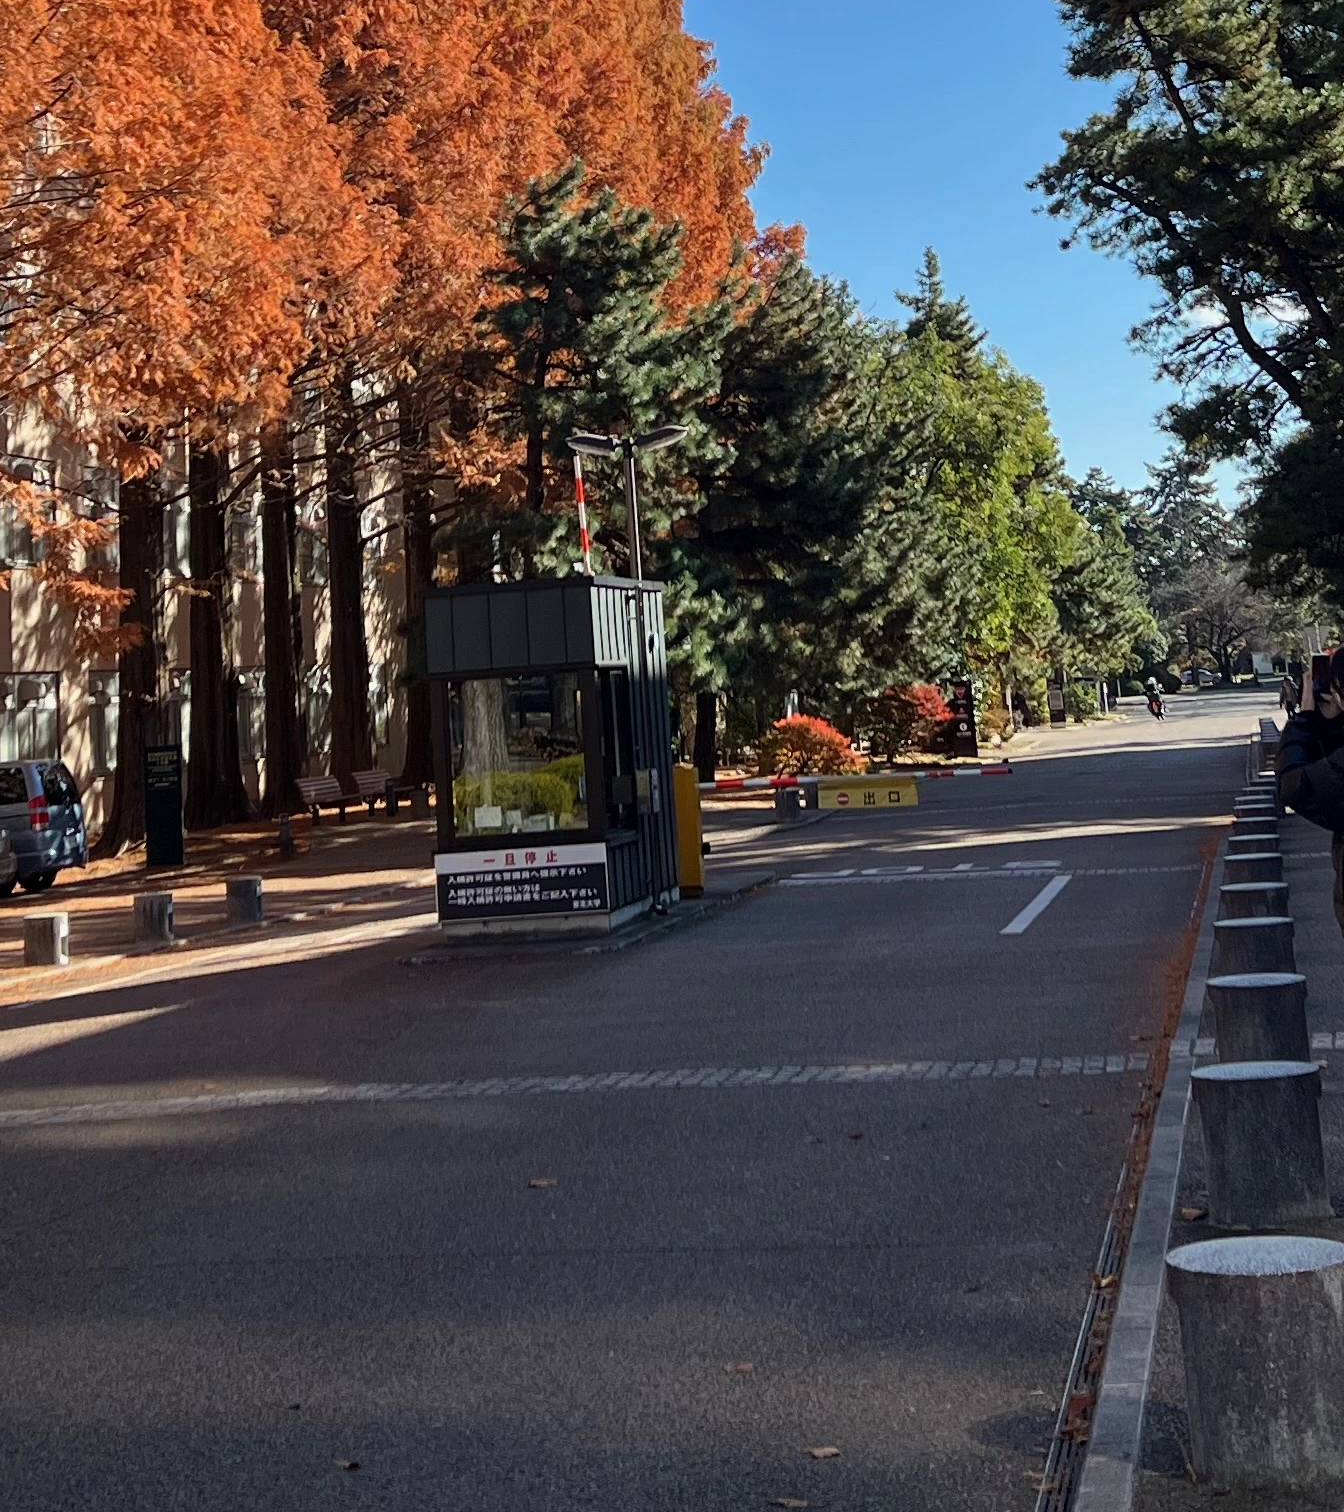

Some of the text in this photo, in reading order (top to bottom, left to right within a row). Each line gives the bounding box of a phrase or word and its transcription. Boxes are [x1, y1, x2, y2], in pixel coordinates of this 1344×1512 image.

[863, 791, 901, 806] 出口
[483, 850, 558, 866] 一旦停止
